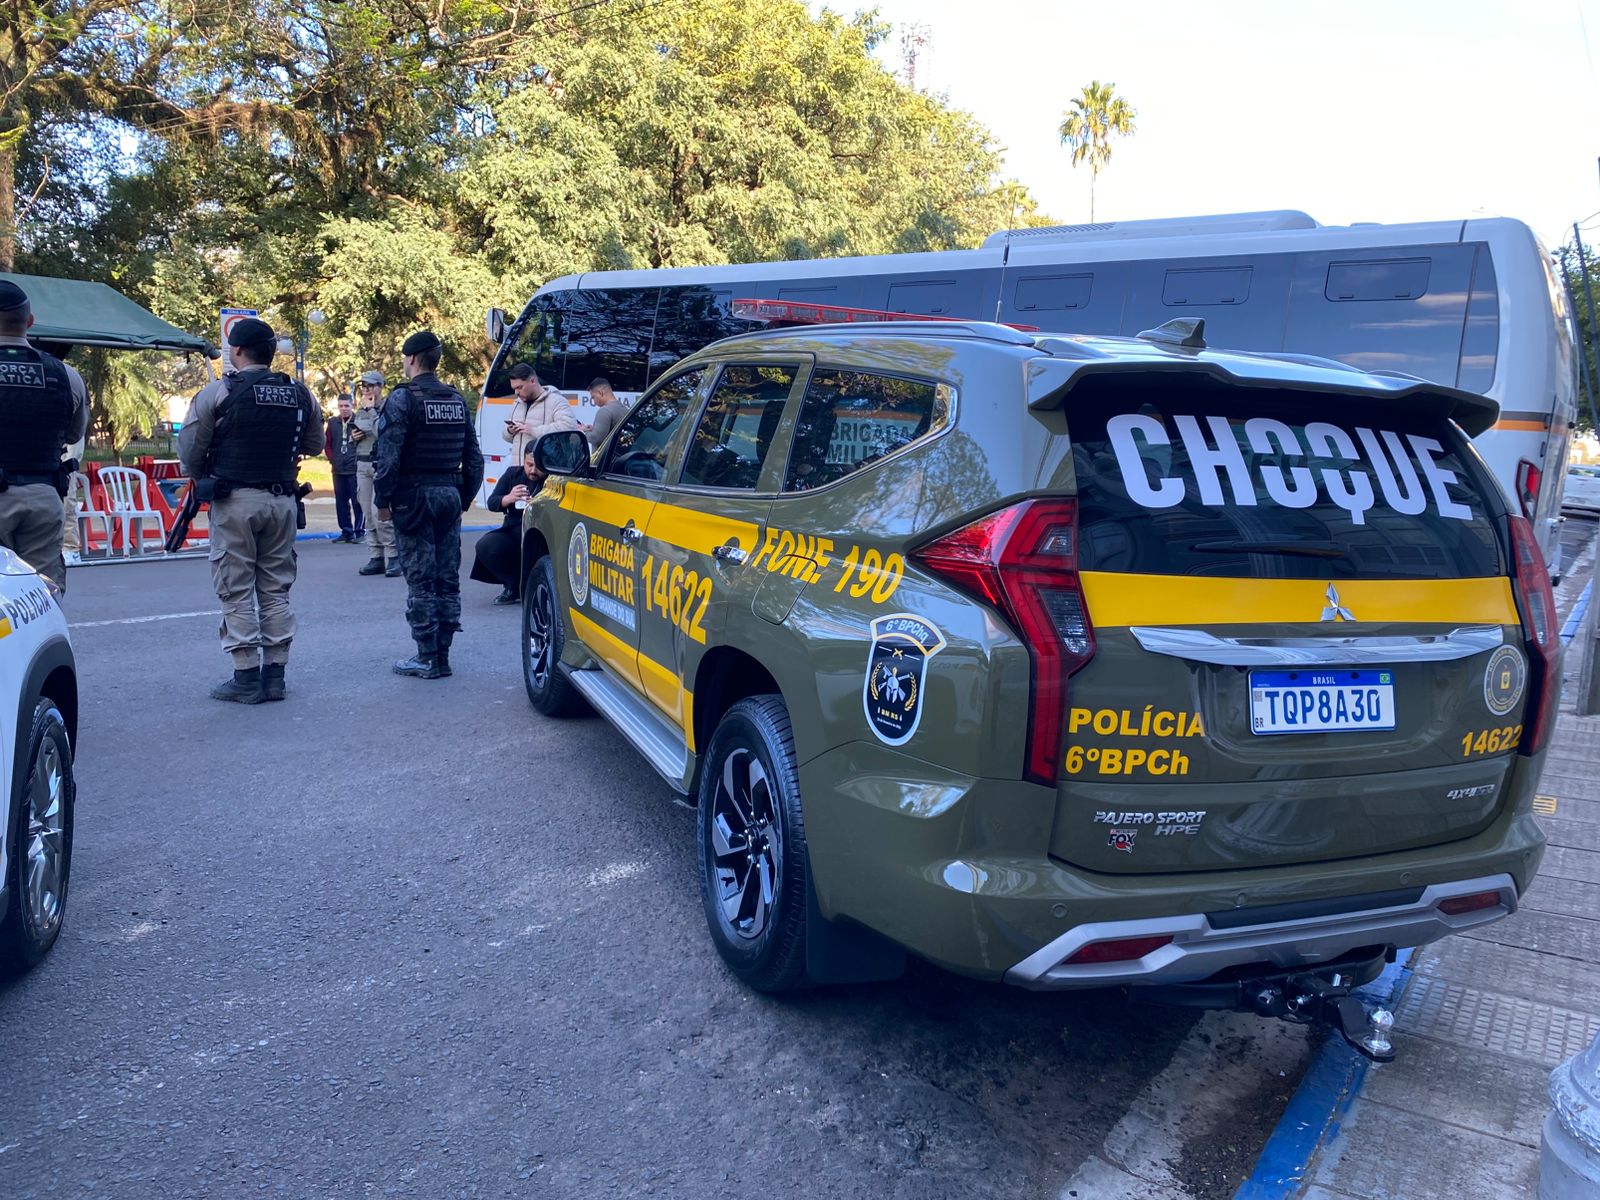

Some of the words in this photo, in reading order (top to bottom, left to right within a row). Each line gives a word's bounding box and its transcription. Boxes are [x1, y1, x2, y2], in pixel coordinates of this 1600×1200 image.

[0, 364, 37, 376] ORÇA
[427, 404, 464, 421] CHOQUE
[1106, 413, 1474, 526] CHOQUE
[590, 533, 635, 573] BRIGADA
[751, 526, 834, 585] FONE
[589, 560, 635, 607] MILITAR
[833, 545, 905, 604] 190
[4, 587, 52, 630] POLÍCIA
[641, 554, 713, 646] 14622
[1312, 676, 1336, 685] BRASIL
[1068, 704, 1206, 737] POLÍCIA
[1255, 717, 1264, 728] BR
[1264, 689, 1381, 725] TQP8A30
[1462, 724, 1523, 757] 14622
[1093, 811, 1155, 825] PAJERO
[1155, 811, 1207, 824] SPORT
[1154, 824, 1201, 836] HPE
[1107, 833, 1136, 850] FOX
